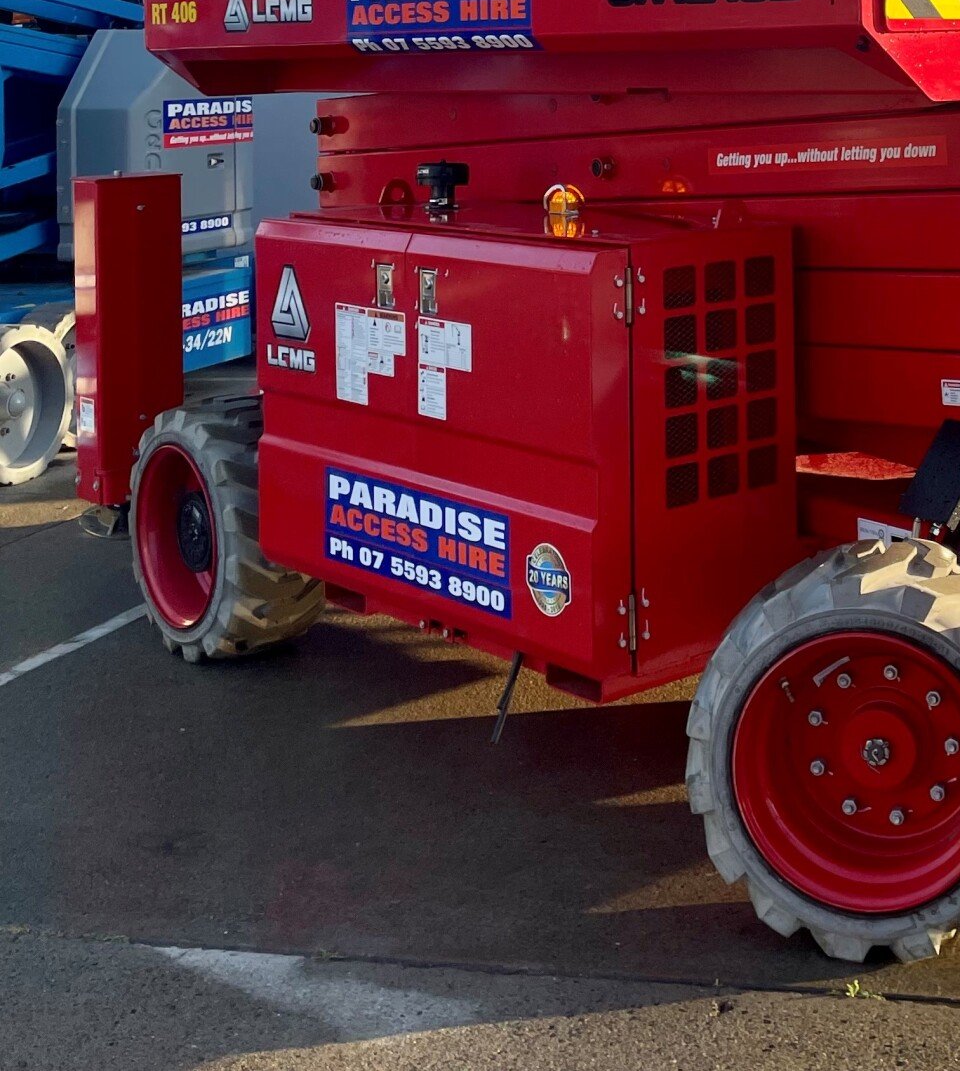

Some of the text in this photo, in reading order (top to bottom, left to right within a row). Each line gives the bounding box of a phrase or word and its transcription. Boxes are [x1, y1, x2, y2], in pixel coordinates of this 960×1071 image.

[151, 1, 197, 25] RT 406
[351, 2, 451, 26] ACCESS
[351, 33, 534, 52] Ph 07 5593 8900
[168, 116, 228, 129] ACCESS
[716, 143, 937, 168] Getting you up...without letting you down
[200, 216, 229, 230] 8900
[216, 305, 249, 323] HIRE
[267, 344, 316, 372] LCMG
[328, 474, 506, 550] PARADISE
[330, 504, 428, 552] ACCESS
[438, 538, 506, 578] HIRE
[330, 537, 505, 611] Ph 07 5593 8900
[529, 570, 568, 589] 20 YEARS
